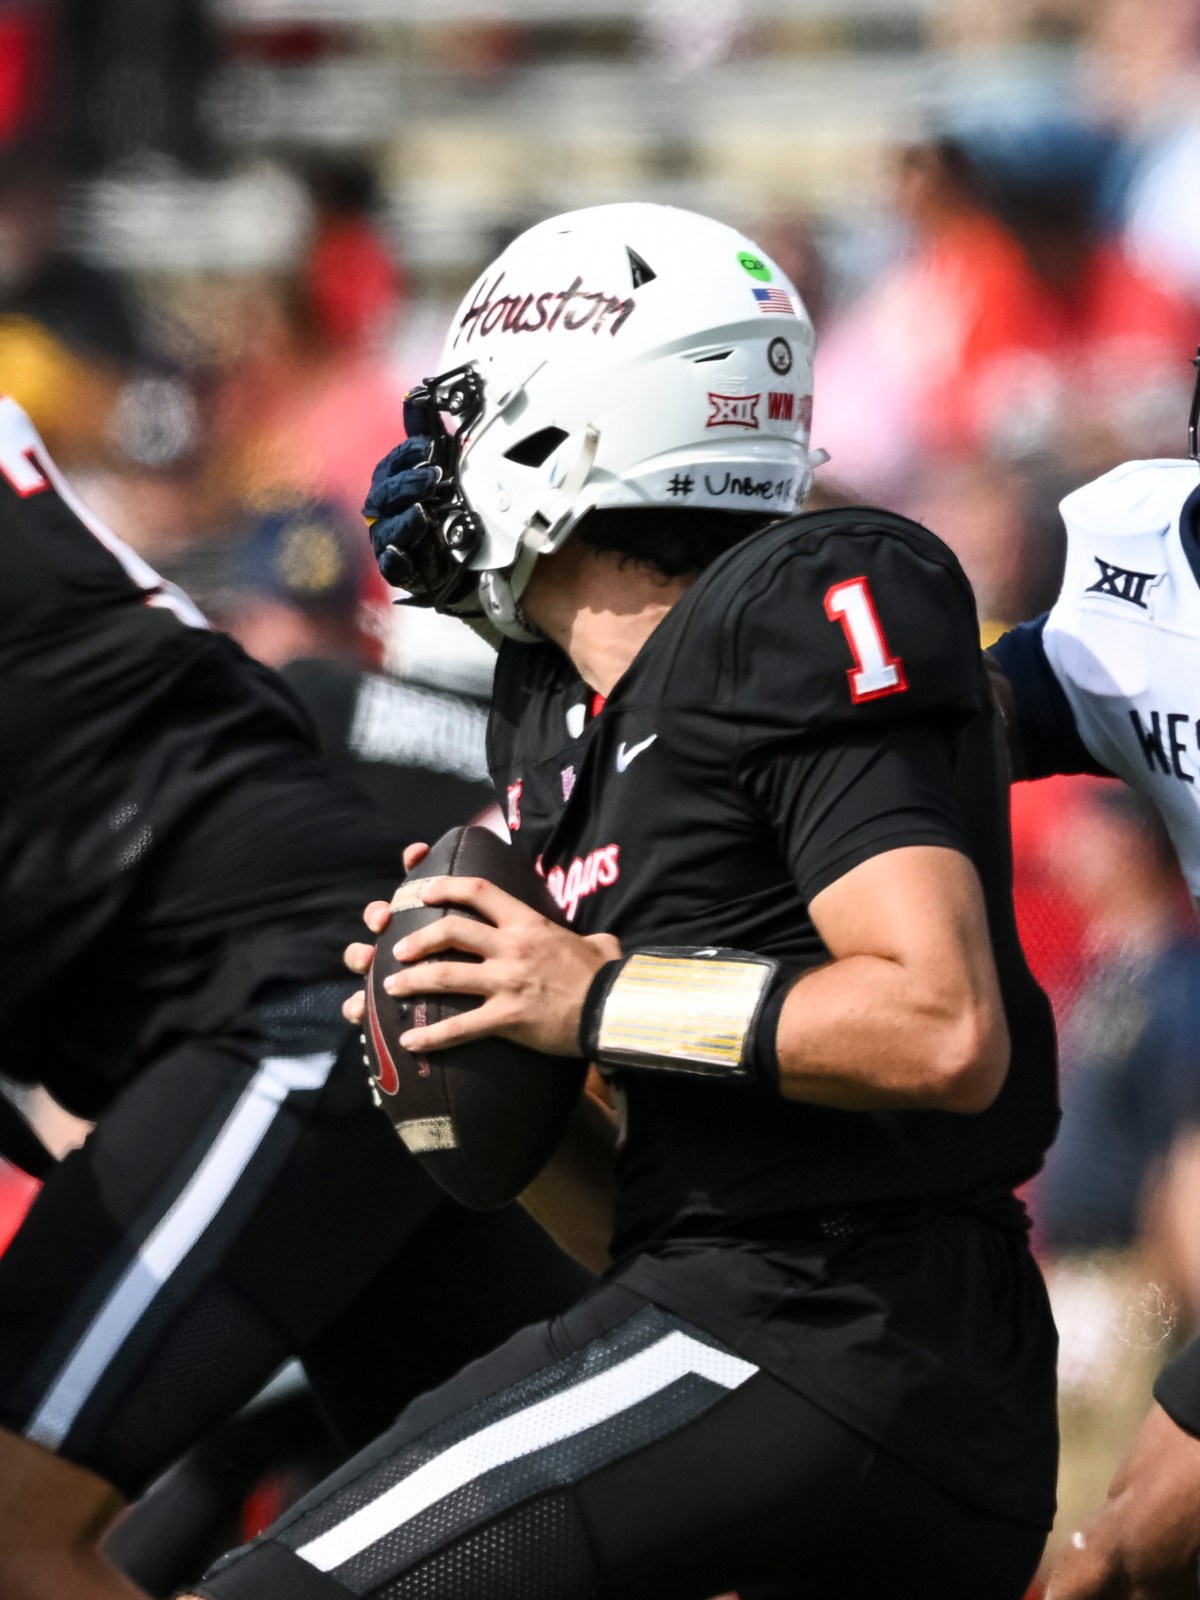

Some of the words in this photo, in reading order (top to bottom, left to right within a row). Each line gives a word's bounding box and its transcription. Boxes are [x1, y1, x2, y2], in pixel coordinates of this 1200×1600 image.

[453, 271, 637, 350] Houston
[1085, 556, 1157, 609] XII
[824, 576, 909, 704] 1
